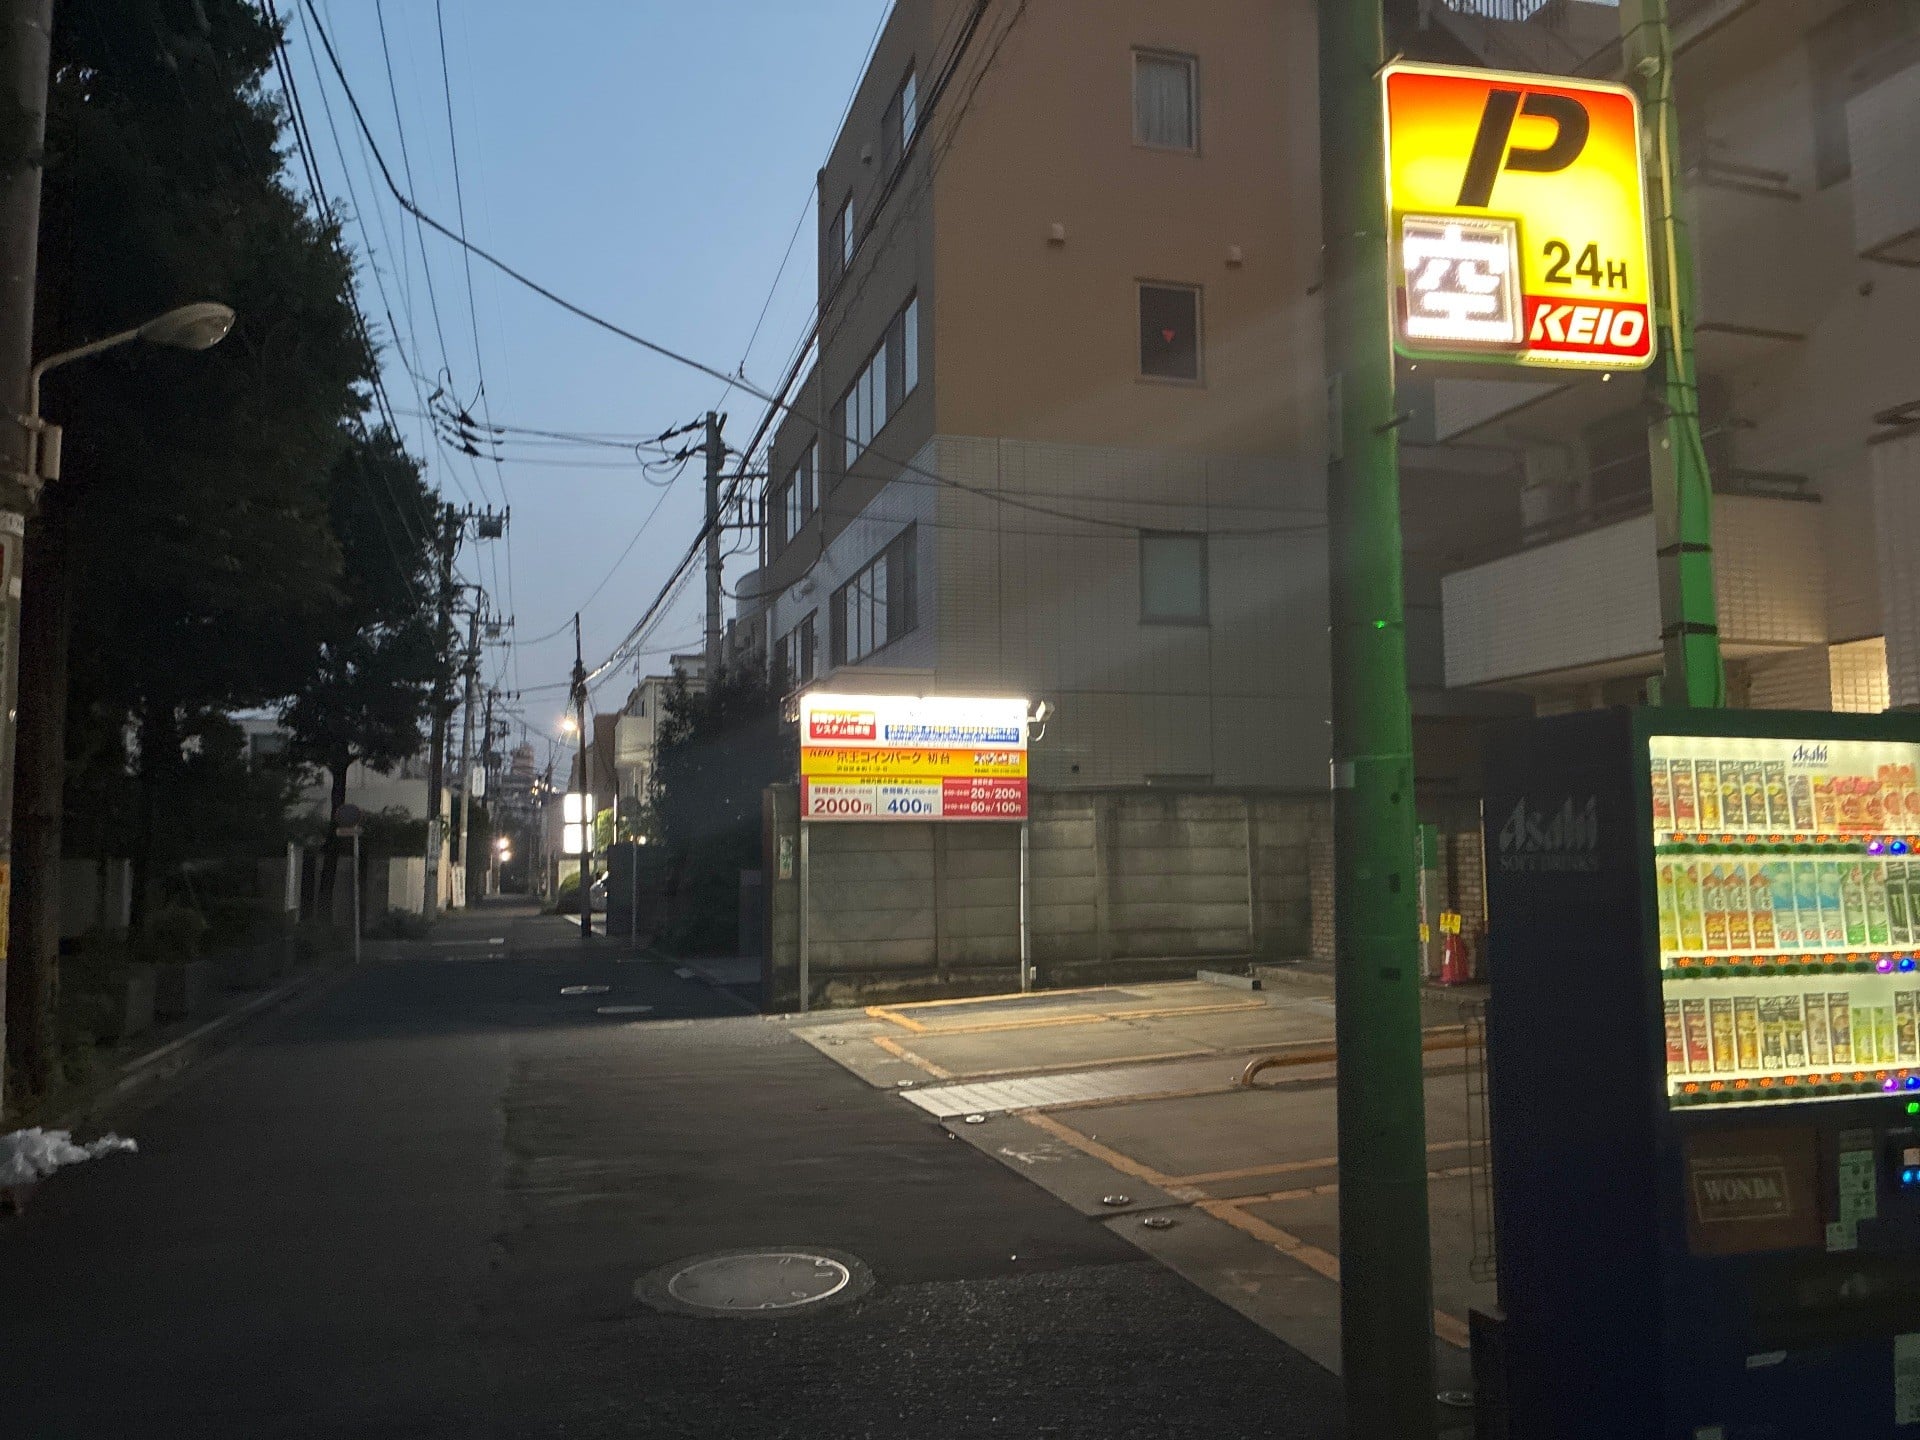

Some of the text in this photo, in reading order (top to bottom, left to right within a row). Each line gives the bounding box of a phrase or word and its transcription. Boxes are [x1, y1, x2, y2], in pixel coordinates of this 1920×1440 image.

[1456, 88, 1590, 207] P
[1403, 224, 1514, 339] 空
[1543, 240, 1628, 290] 24H
[1529, 303, 1645, 347] KEIO
[1792, 744, 1828, 762] Asahi
[814, 797, 872, 815] 2000円
[887, 798, 933, 815] 400円
[1500, 797, 1598, 853] Asahi
